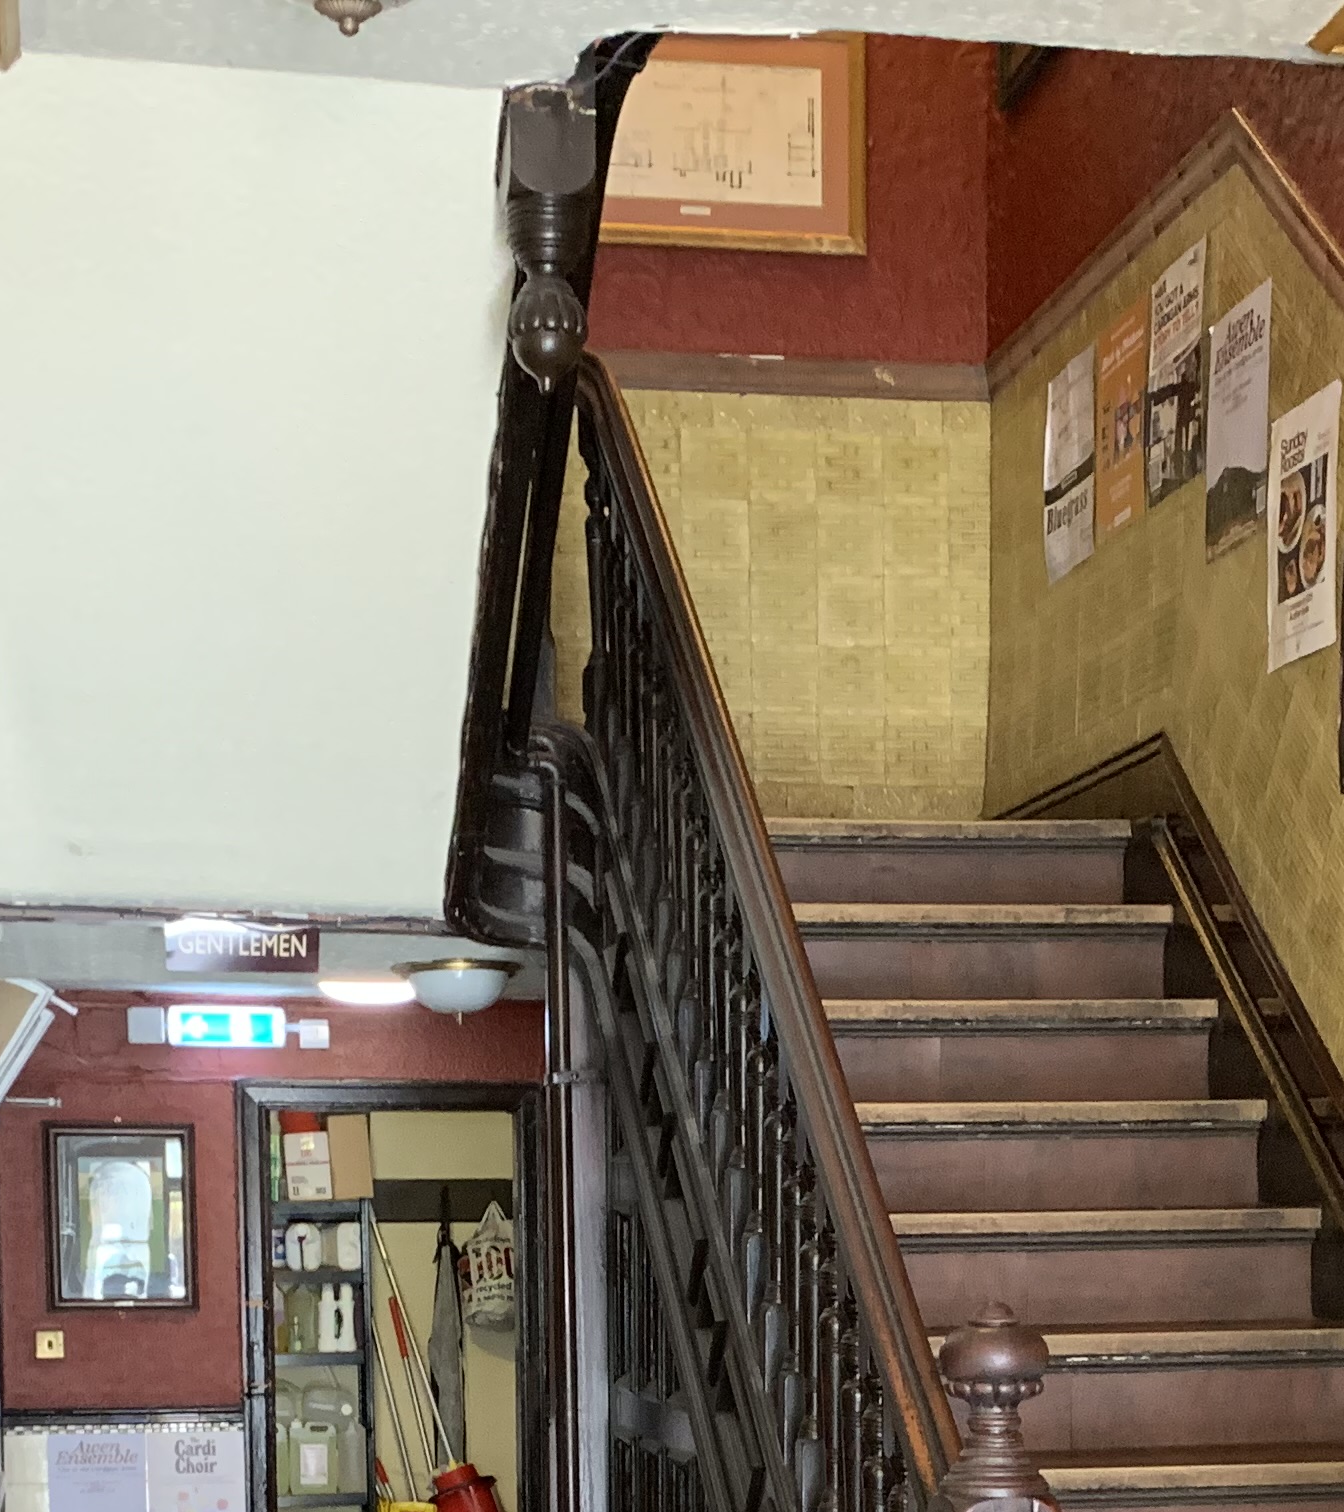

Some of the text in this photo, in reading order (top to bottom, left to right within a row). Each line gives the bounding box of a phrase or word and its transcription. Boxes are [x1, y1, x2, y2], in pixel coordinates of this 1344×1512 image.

[1281, 428, 1308, 453] Sunday
[1281, 449, 1305, 476] Roasts
[1047, 488, 1088, 537] Bluegrass
[178, 933, 307, 958] GENTLEMEN
[56, 1449, 138, 1466] Ensemble
[73, 1440, 120, 1455] Awen
[175, 1438, 216, 1456] Cardi
[175, 1456, 217, 1474] Choir
